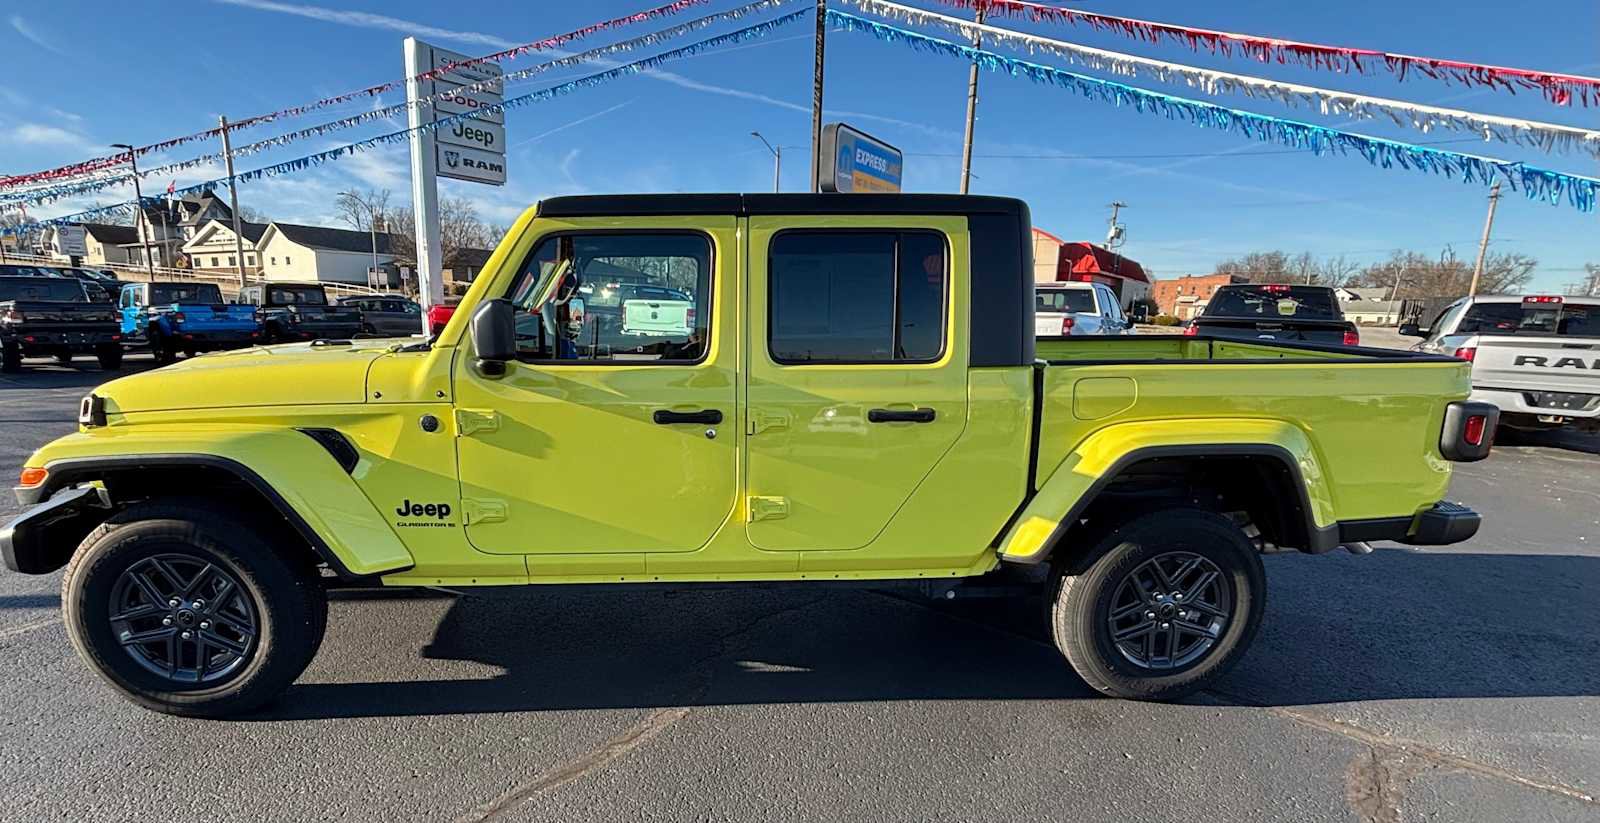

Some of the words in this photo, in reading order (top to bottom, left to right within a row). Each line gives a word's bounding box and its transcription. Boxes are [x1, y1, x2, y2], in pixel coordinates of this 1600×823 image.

[452, 121, 494, 147] Jeep
[463, 158, 503, 173] RAM
[855, 147, 887, 172] EXPRESS
[396, 499, 451, 519] Jeep
